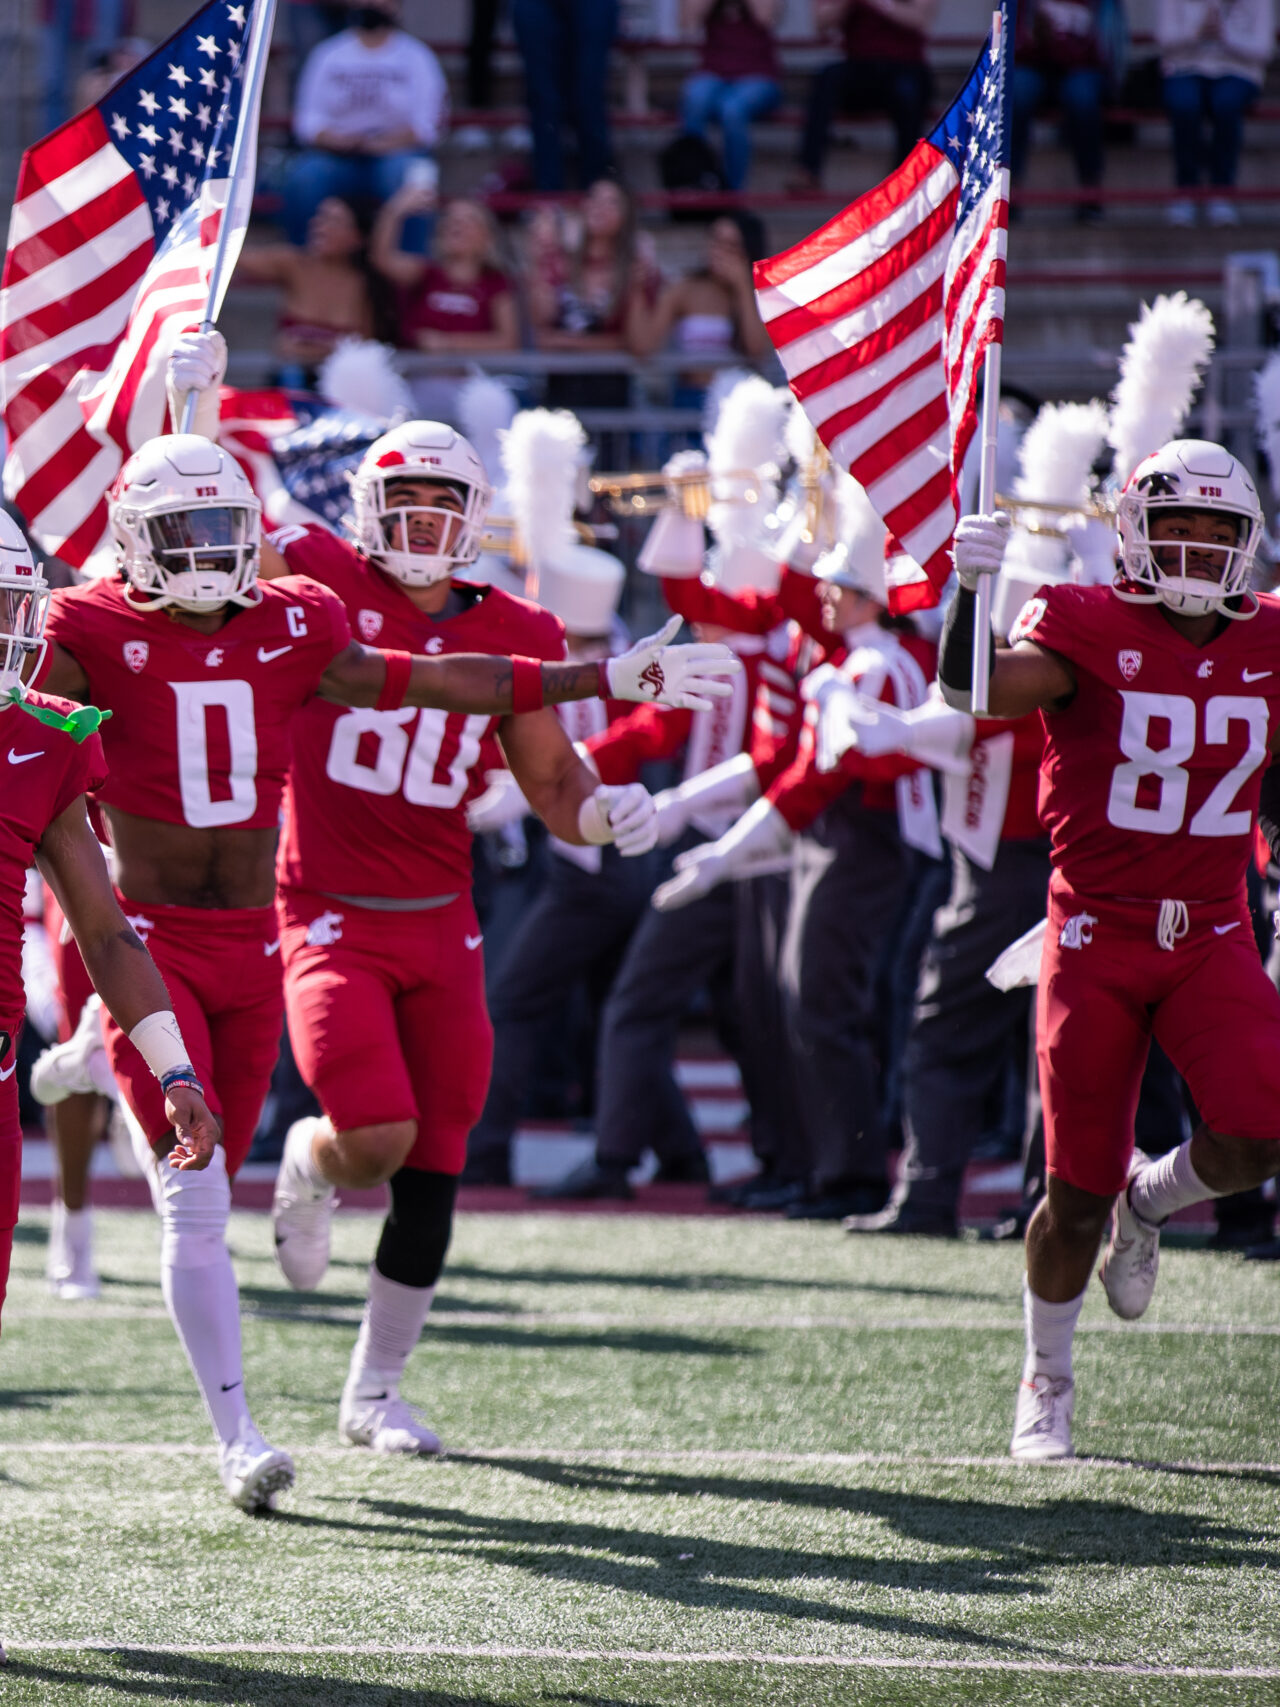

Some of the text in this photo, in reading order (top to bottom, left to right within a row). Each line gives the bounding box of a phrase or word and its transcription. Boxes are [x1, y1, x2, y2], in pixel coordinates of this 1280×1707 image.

[1199, 486, 1222, 498] WSU
[285, 606, 308, 638] C
[167, 679, 258, 828] 0
[1107, 689, 1270, 837] 82
